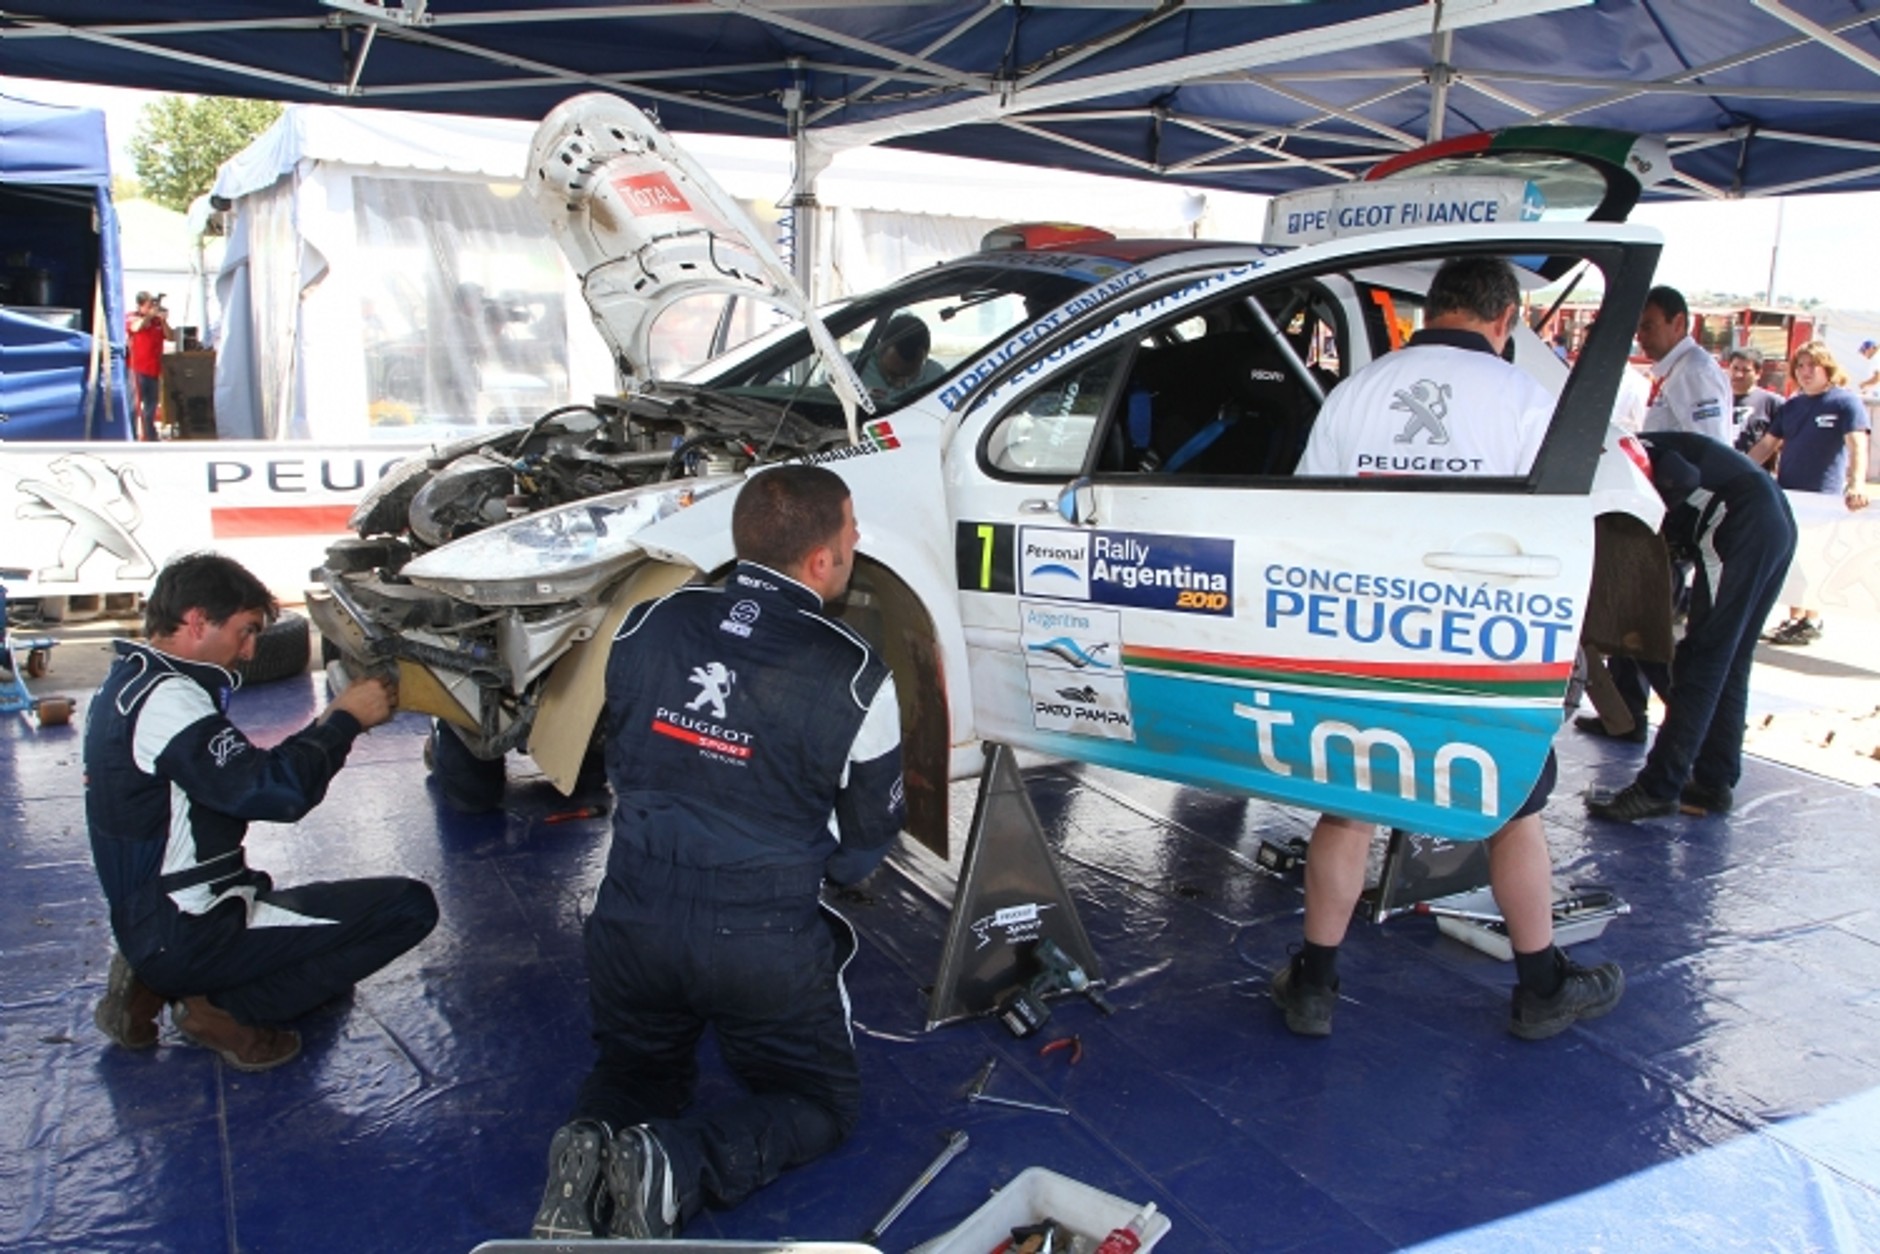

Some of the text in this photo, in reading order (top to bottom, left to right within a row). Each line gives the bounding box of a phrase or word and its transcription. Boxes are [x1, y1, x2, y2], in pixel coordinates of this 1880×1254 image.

[619, 184, 681, 210] TOTAL
[1302, 205, 1396, 232] PEGEOT
[207, 457, 407, 493] PEU
[1358, 453, 1483, 473] PEUGEOT
[1026, 544, 1086, 561] Personal
[1095, 536, 1150, 567] Rally
[1092, 558, 1228, 591] Argentina
[1176, 590, 1229, 611] 2010
[1265, 564, 1574, 620] CONCESSIONÁRIOS
[1028, 610, 1090, 630] Argentina
[1266, 588, 1574, 664] PEUGEOT
[656, 707, 754, 745] PEUGEOT
[1233, 691, 1499, 818] tmn
